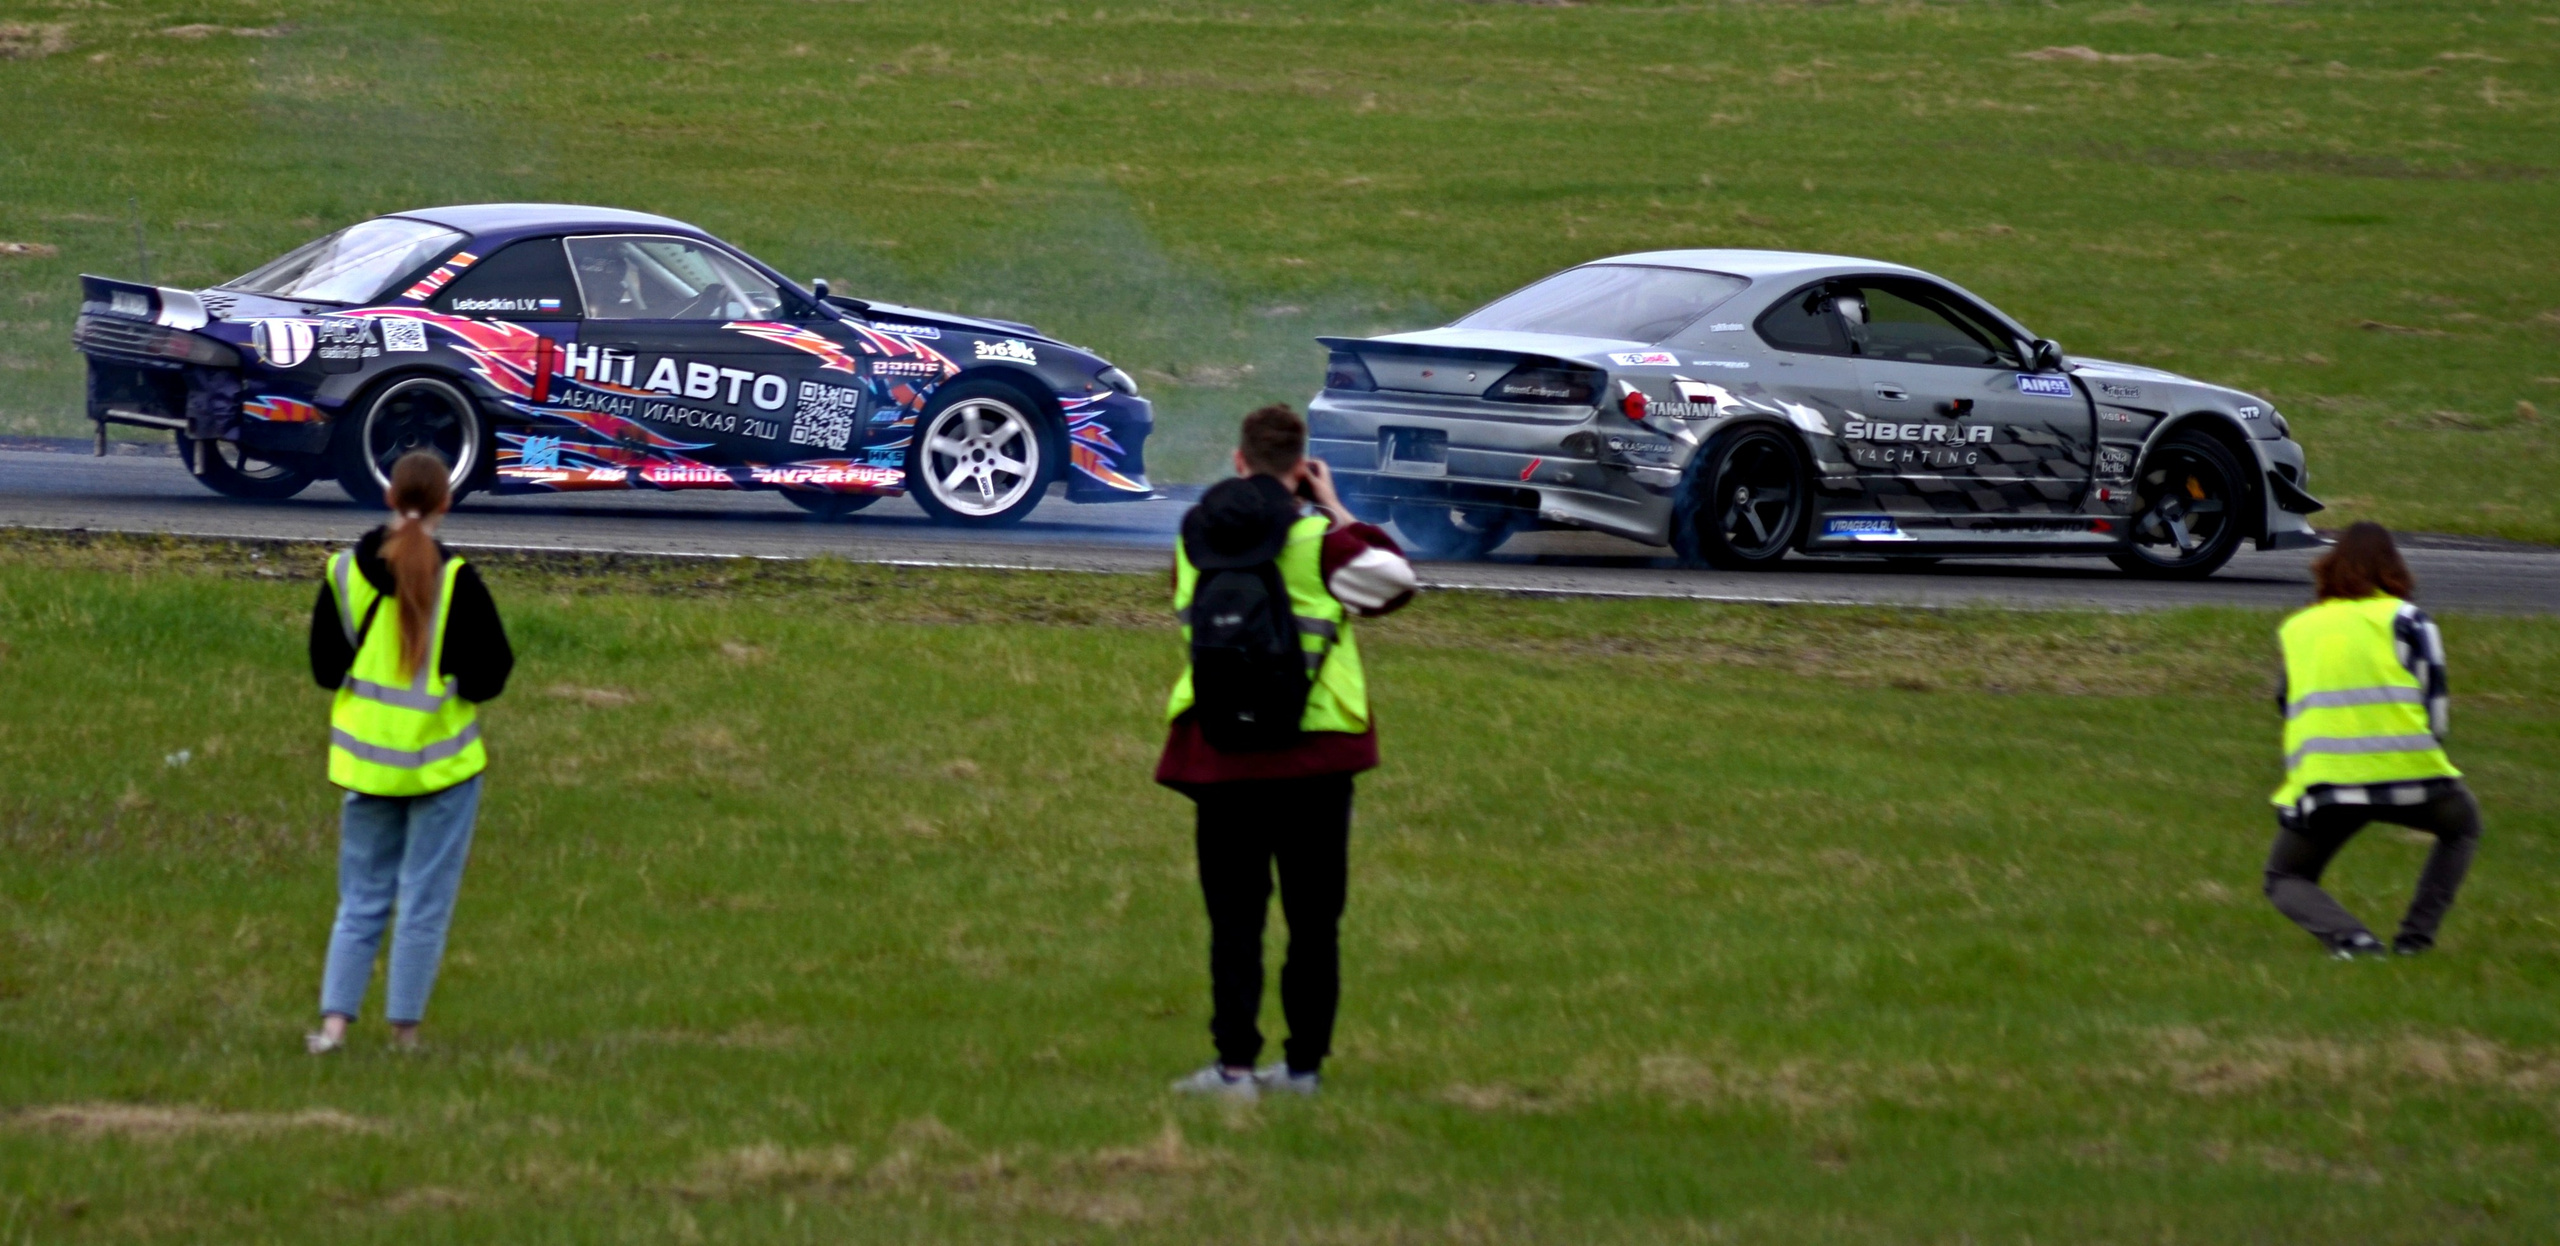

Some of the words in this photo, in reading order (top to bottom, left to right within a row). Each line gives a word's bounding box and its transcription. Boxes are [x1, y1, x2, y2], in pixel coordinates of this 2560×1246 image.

[563, 342, 635, 387] НП
[644, 357, 788, 410] АВТО
[560, 388, 635, 416] АБАКАН
[643, 401, 738, 433] ИГАРСКАЯ
[741, 418, 779, 441] 21Ш
[1649, 401, 1721, 418] TAKAYAMA
[1856, 448, 1978, 465] YACHTING
